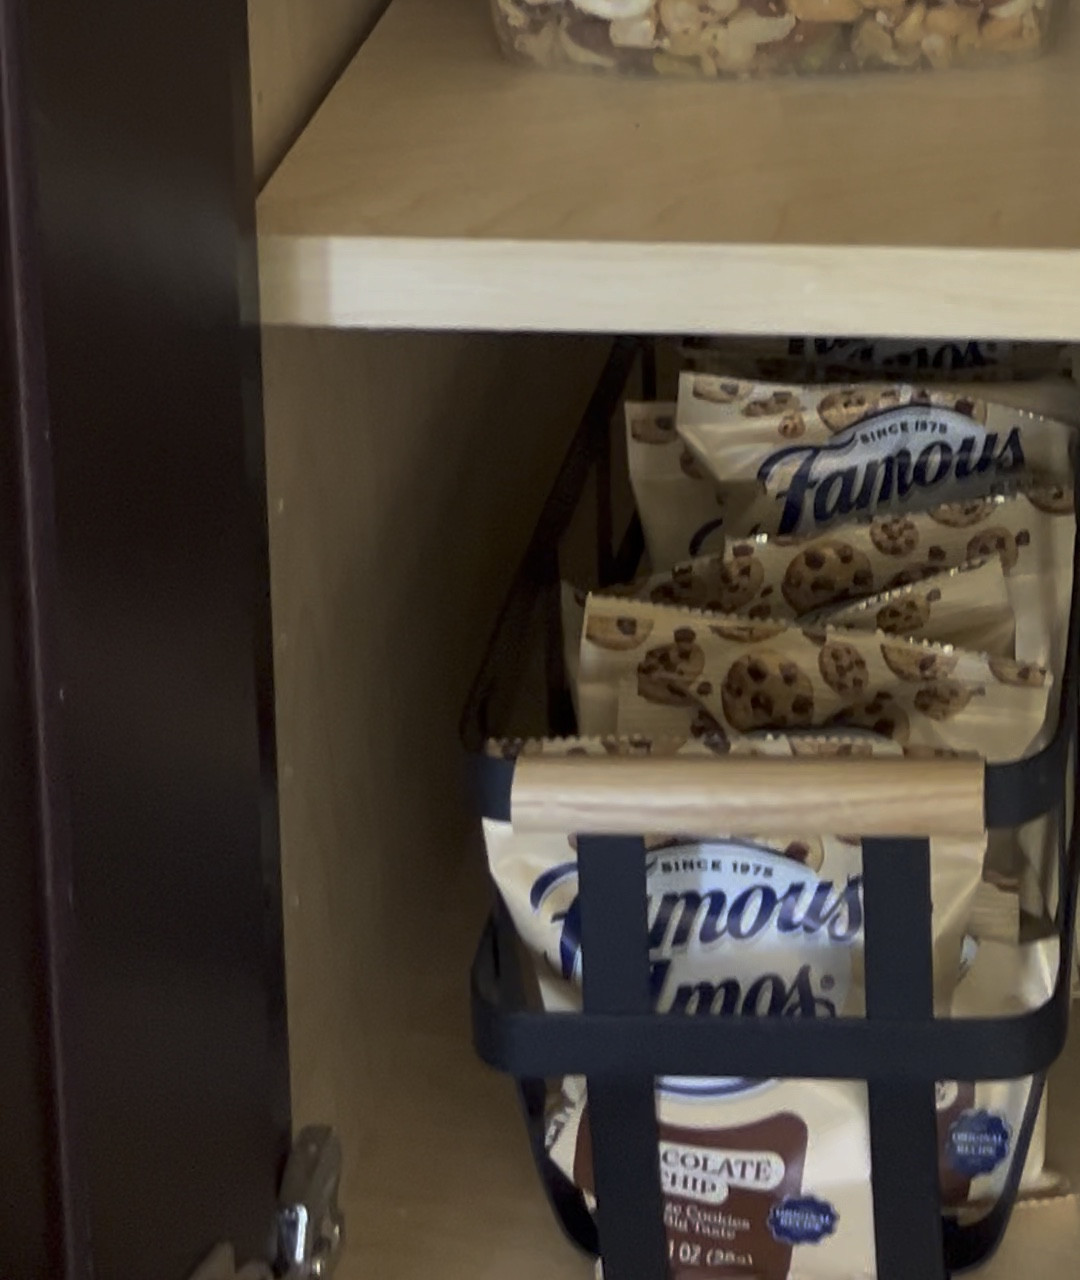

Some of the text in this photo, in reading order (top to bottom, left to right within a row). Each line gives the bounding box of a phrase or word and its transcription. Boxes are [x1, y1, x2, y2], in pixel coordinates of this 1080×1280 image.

[755, 426, 1026, 538] Famous
[661, 858, 723, 874] SINCE
[661, 1147, 773, 1183] COLATE
